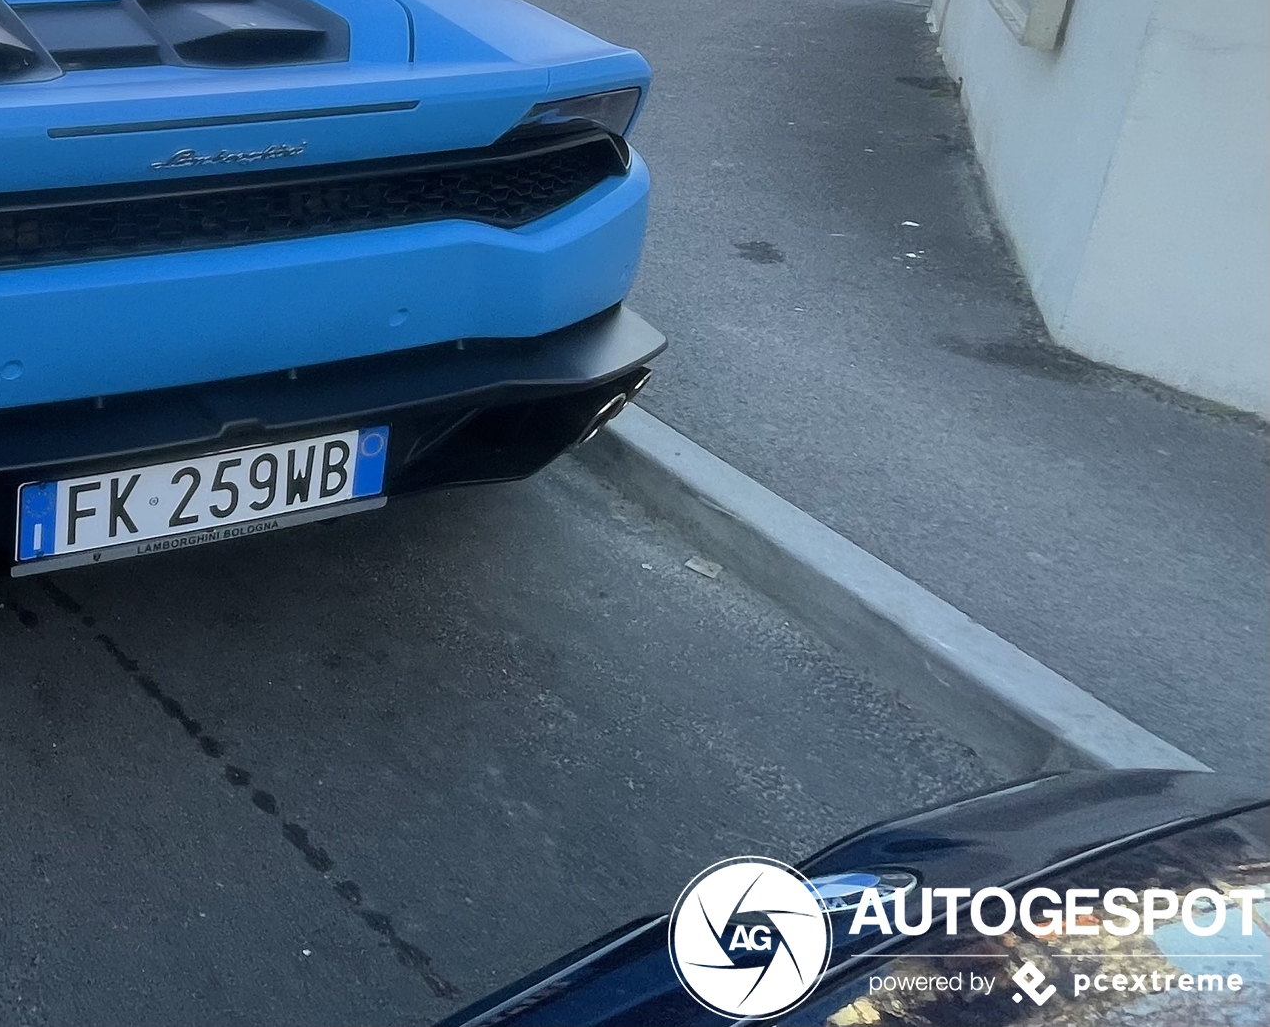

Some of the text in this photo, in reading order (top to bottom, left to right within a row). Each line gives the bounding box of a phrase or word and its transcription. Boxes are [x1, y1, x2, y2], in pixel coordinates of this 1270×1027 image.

[67, 473, 142, 545] FK
[169, 439, 352, 528] 259WB
[137, 519, 280, 555] LAMBORGHINI BOLOGNA
